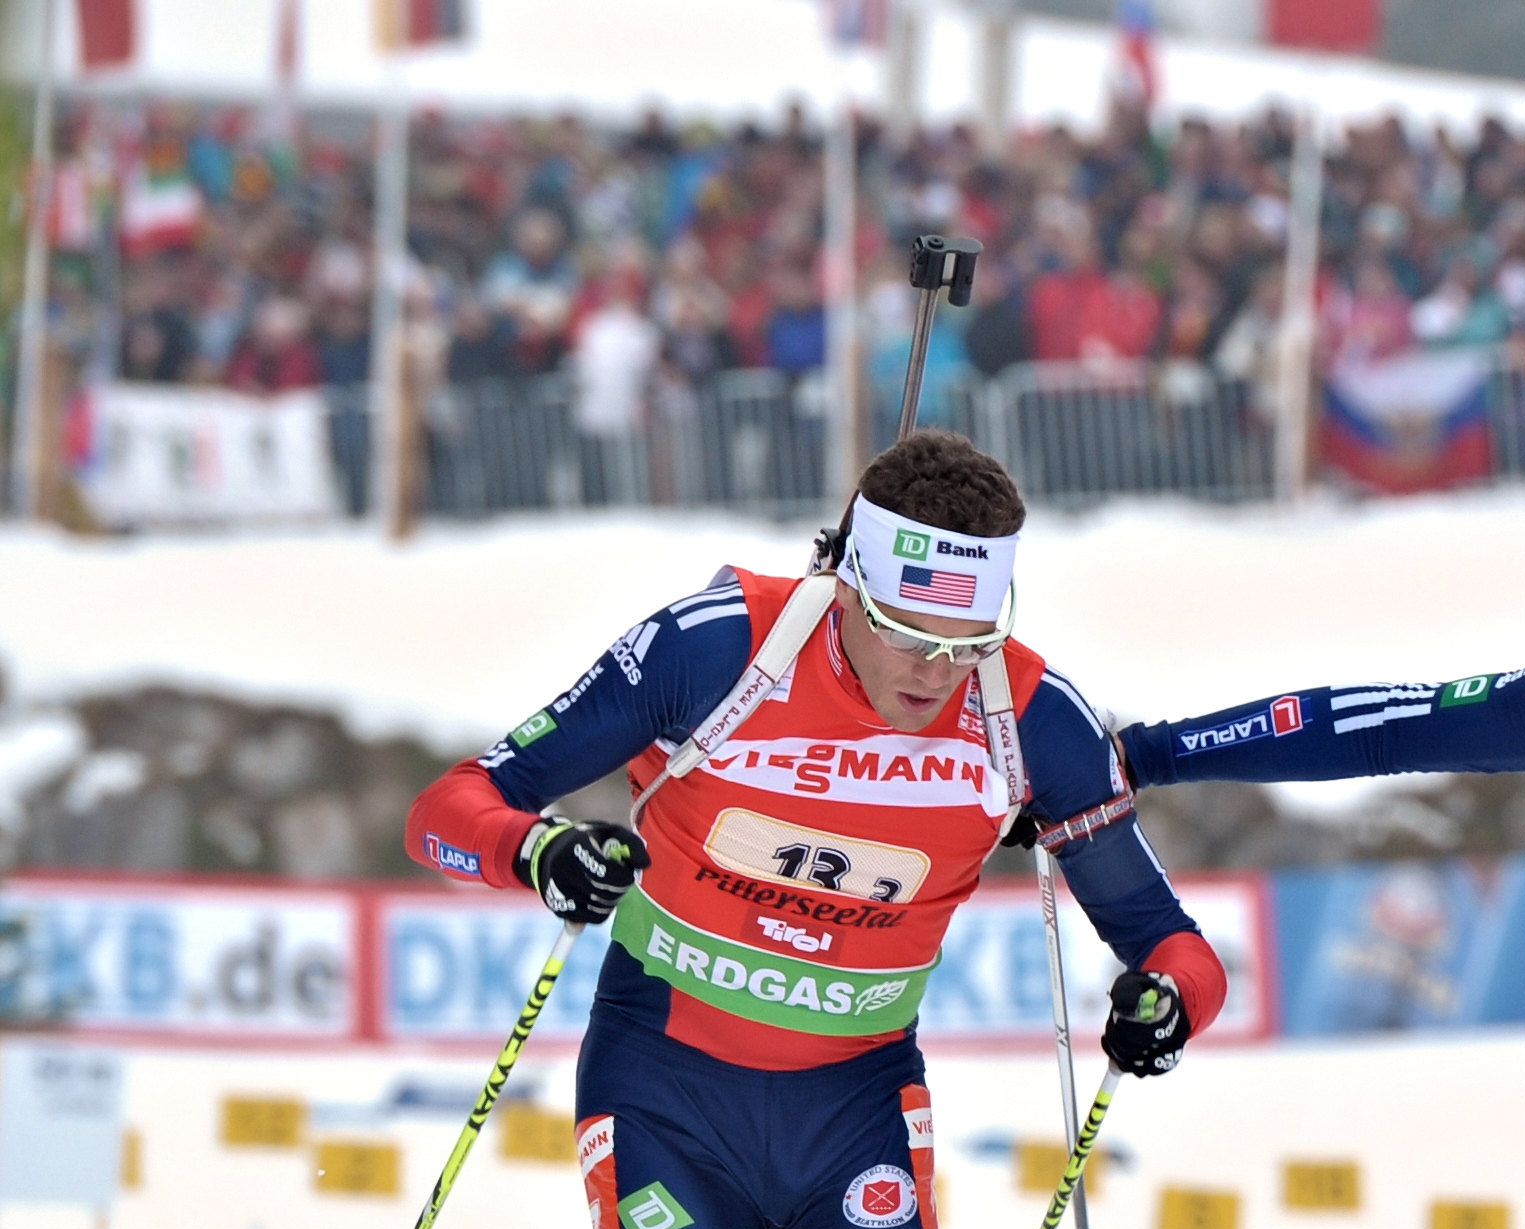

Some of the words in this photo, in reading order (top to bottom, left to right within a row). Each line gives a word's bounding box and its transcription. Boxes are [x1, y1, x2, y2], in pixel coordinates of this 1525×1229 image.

[936, 540, 989, 561] Bank
[552, 665, 605, 714] Bank
[739, 673, 765, 707] LAKE
[699, 705, 741, 748] PLACID
[997, 714, 1013, 749] LAKE
[1180, 714, 1269, 751] LAPUA
[1004, 753, 1019, 803] PLACID
[772, 842, 852, 891] 13
[756, 915, 834, 954] Tirol
[645, 922, 856, 1016] ERDGAS
[850, 1166, 883, 1192] UNITED
[884, 1166, 913, 1188] STATES
